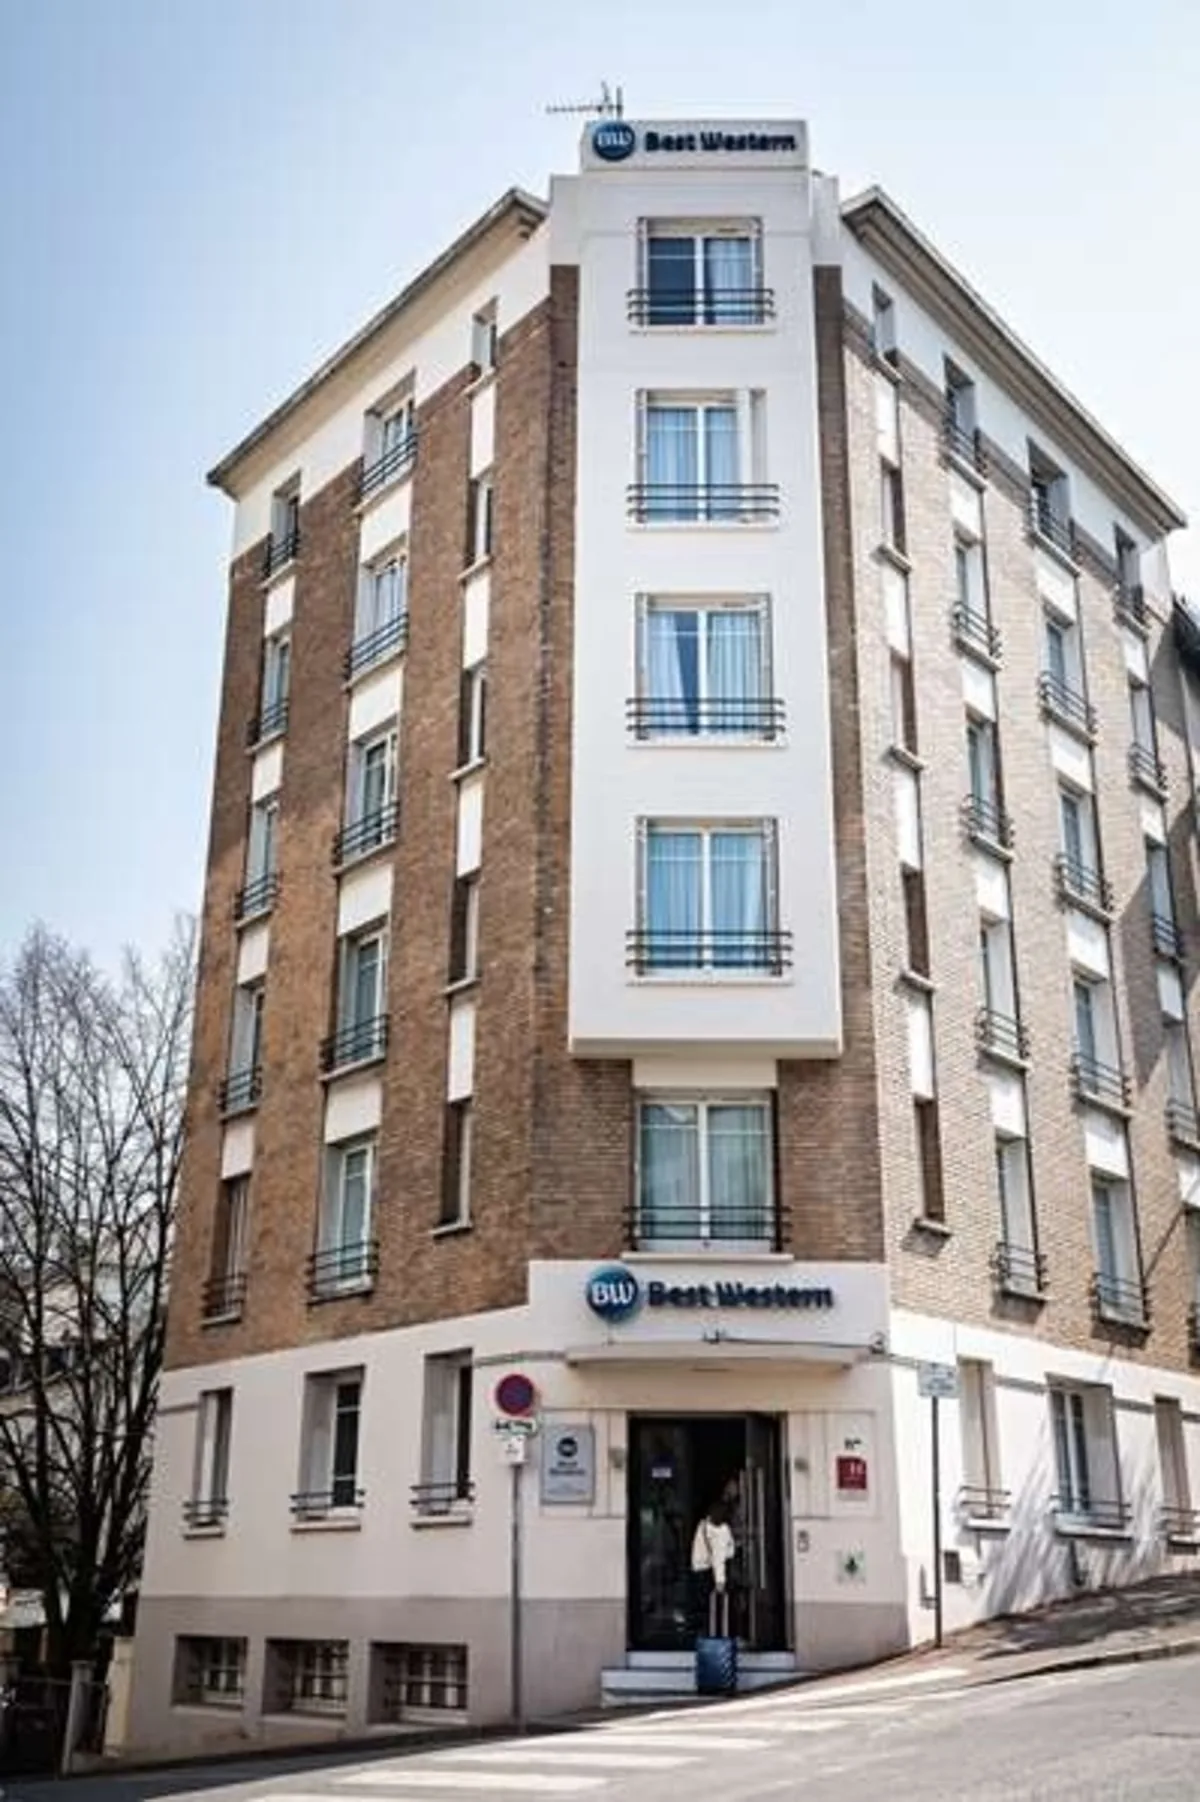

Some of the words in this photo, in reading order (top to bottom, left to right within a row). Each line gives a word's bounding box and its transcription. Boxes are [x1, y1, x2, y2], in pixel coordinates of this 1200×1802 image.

[645, 132, 697, 151] Best
[700, 132, 797, 151] Western
[591, 1281, 634, 1305] BW
[647, 1281, 711, 1307] Best
[714, 1281, 834, 1308] Western
